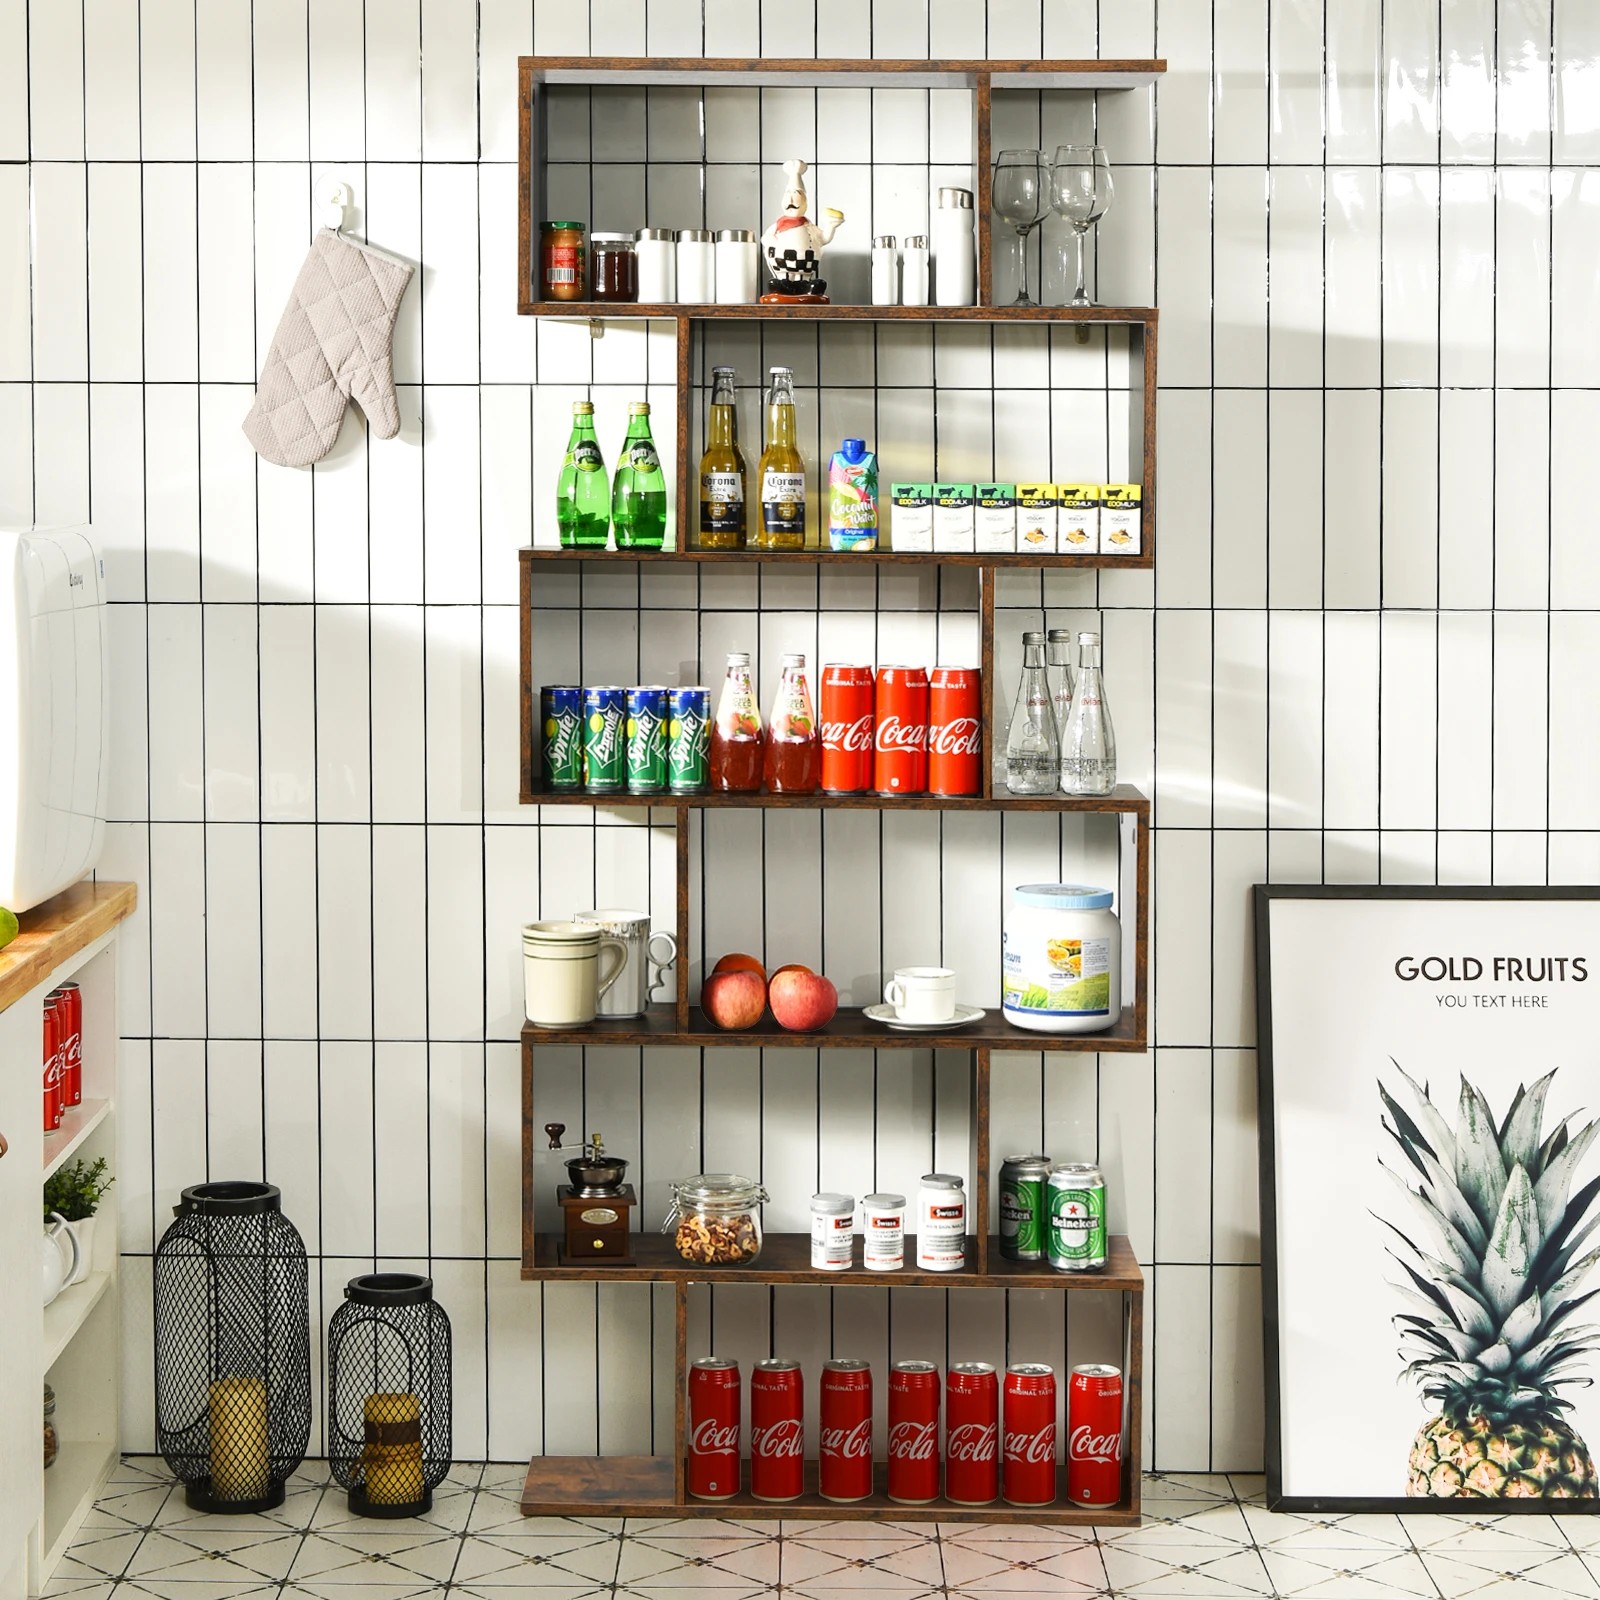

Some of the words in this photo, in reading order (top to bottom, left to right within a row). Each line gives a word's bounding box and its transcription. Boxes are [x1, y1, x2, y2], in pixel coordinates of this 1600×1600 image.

[702, 475, 736, 488] Corona
[832, 495, 877, 516] Coconut
[849, 512, 875, 524] Water
[550, 714, 575, 768] Sprite
[628, 715, 654, 768] Sprite
[670, 716, 699, 770] Sprite
[1394, 956, 1483, 982] GOLD
[1493, 956, 1589, 982] FRUITS
[1436, 995, 1467, 1008] YOU
[1473, 995, 1507, 1008] TEXT
[1512, 995, 1549, 1008] HERE
[935, 1209, 959, 1218] Swisse
[876, 1219, 896, 1228] Swisse
[1052, 1216, 1098, 1229] Heineken
[954, 1386, 972, 1395] TASTE
